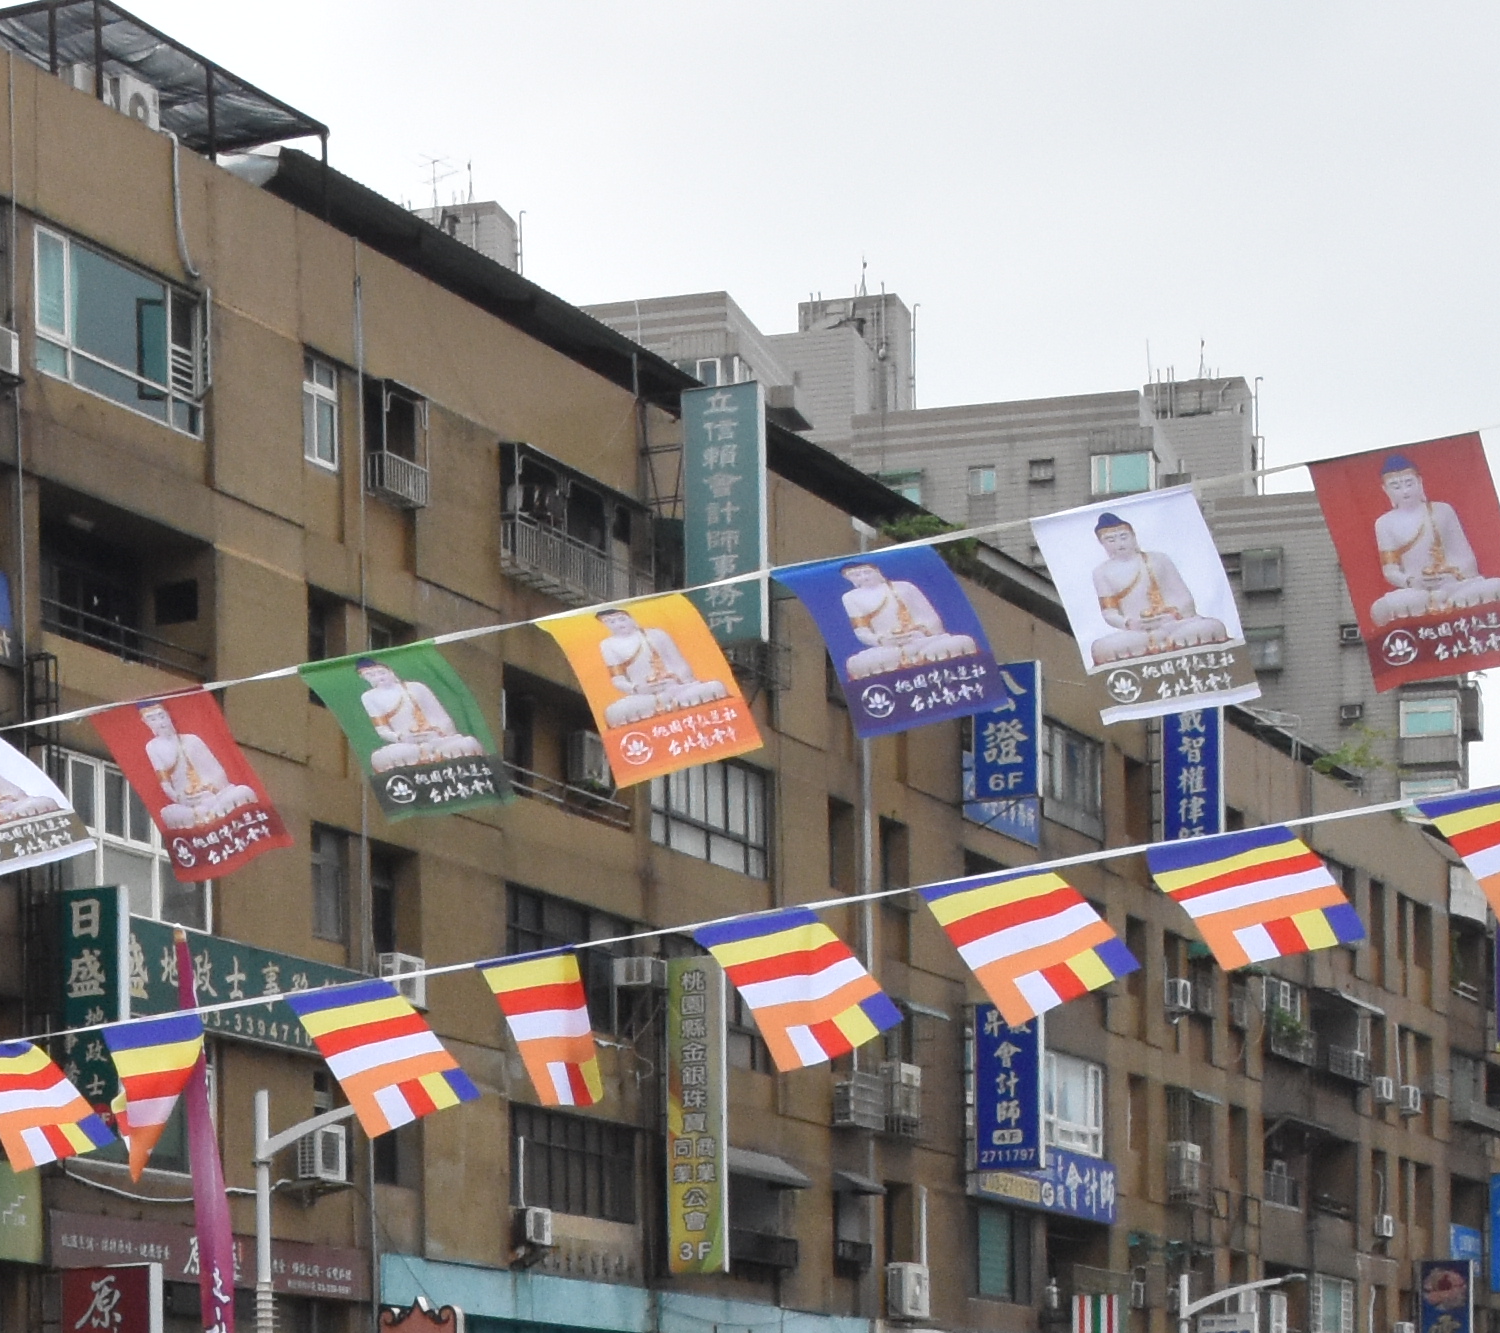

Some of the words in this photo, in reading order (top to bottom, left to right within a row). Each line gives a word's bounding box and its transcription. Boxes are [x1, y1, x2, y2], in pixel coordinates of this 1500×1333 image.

[988, 771, 1024, 792] 6F
[67, 898, 106, 998] 日盛
[981, 1148, 1036, 1163] 2711797
[679, 1242, 712, 1262] 3F
